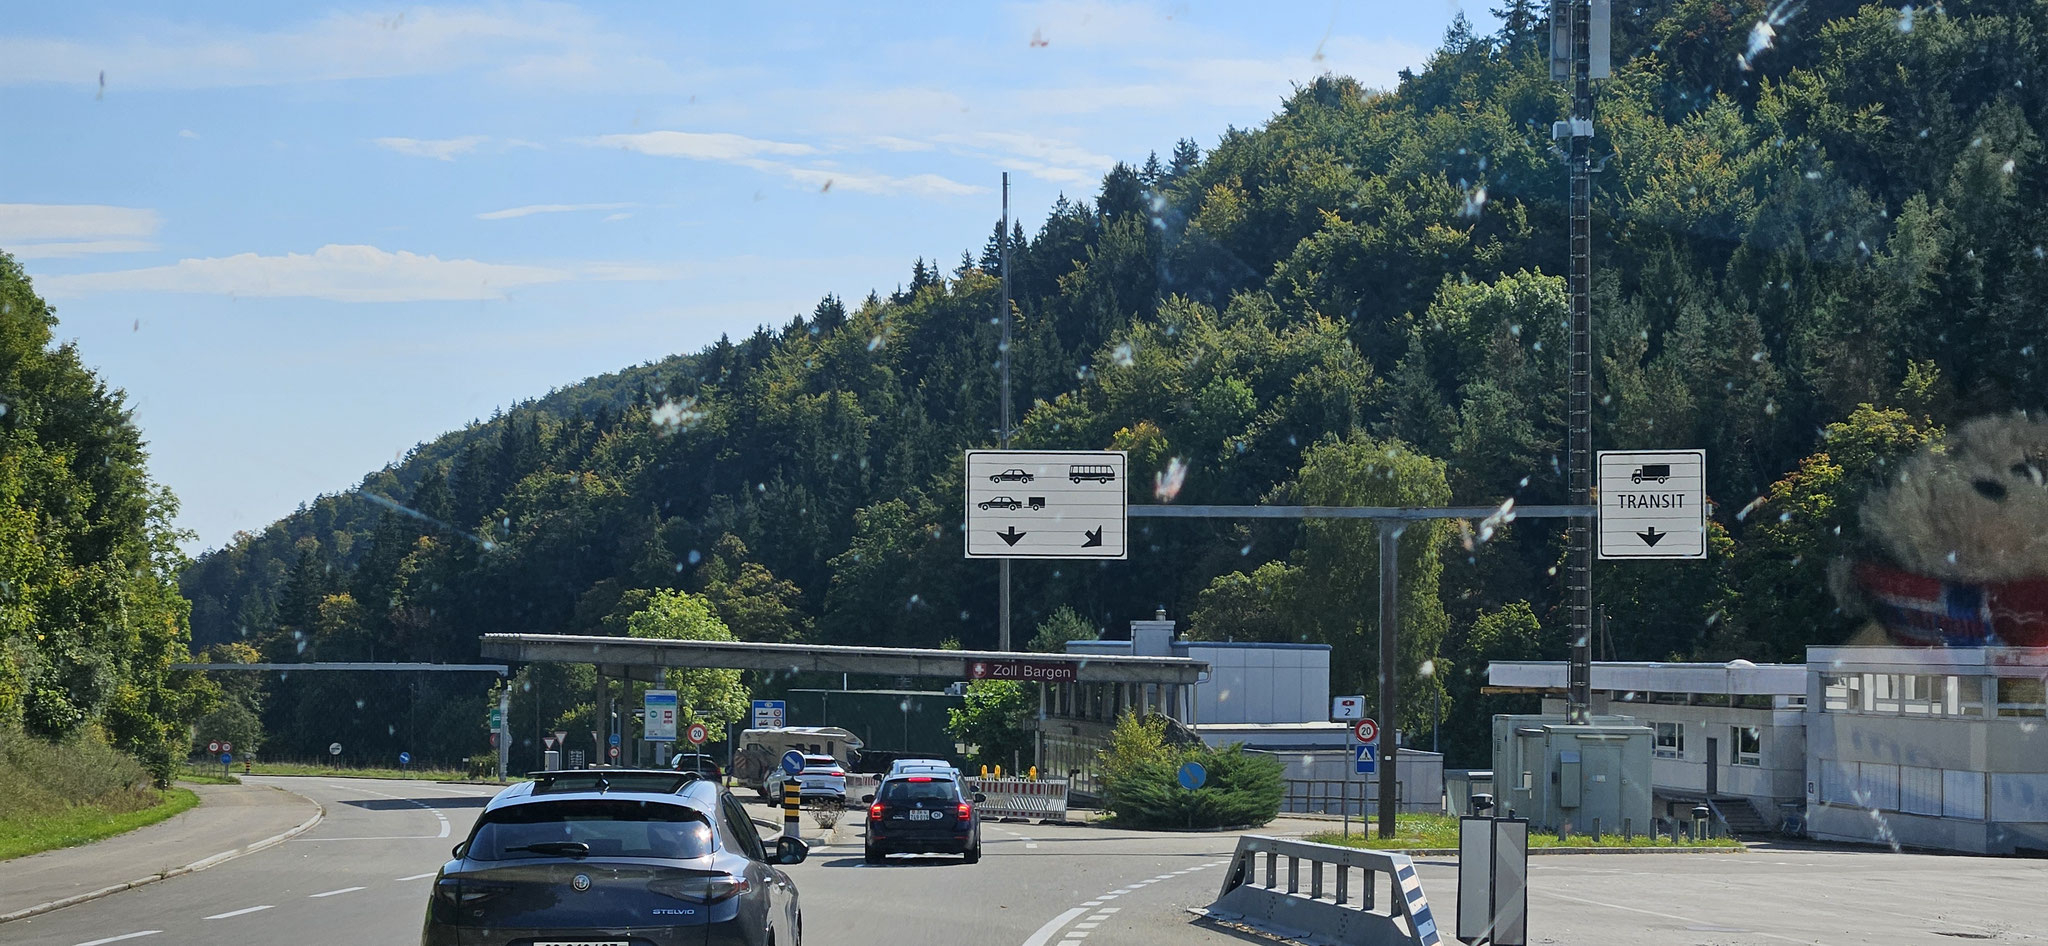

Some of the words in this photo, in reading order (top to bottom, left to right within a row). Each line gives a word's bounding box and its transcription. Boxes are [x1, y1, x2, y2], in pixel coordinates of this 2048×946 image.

[1617, 493, 1685, 509] TRANSIT
[993, 664, 1017, 676] Zoll
[1023, 665, 1071, 680] Bargen
[1344, 707, 1351, 716] 2
[693, 730, 702, 738] 20
[1361, 726, 1372, 736] 20
